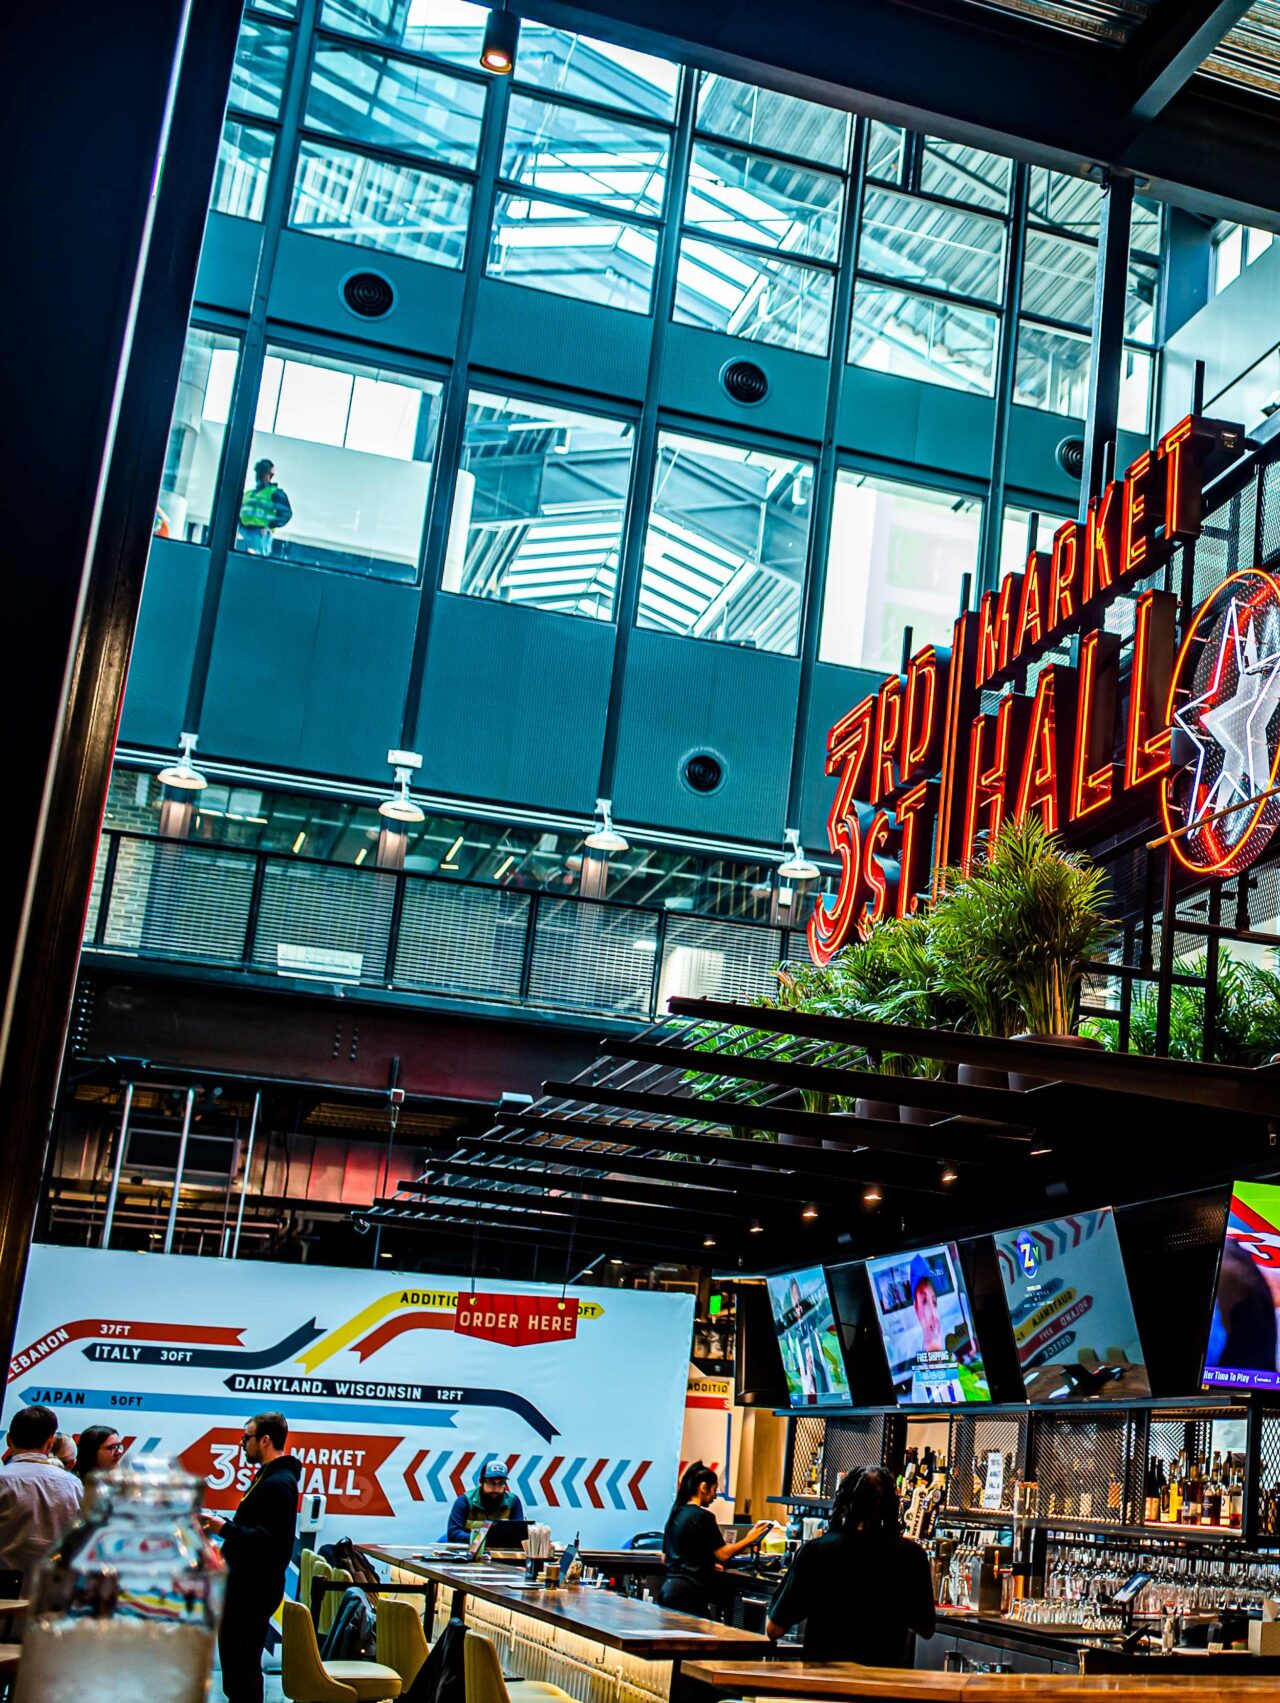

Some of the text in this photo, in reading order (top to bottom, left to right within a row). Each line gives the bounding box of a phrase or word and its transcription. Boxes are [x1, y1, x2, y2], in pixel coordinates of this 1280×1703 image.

[976, 413, 1193, 688] MARKET
[962, 588, 1174, 878] HALL
[807, 645, 939, 968] 3RD
[99, 1324, 132, 1337] 37FT
[459, 1311, 574, 1332] ORDER HERE
[94, 1345, 142, 1361] ITALY
[1214, 1370, 1229, 1381] Time
[31, 1389, 86, 1406] JAPAN
[335, 1382, 423, 1401] WISCONSIN
[436, 1389, 464, 1401] 12FT
[289, 1446, 366, 1467] MARKET
